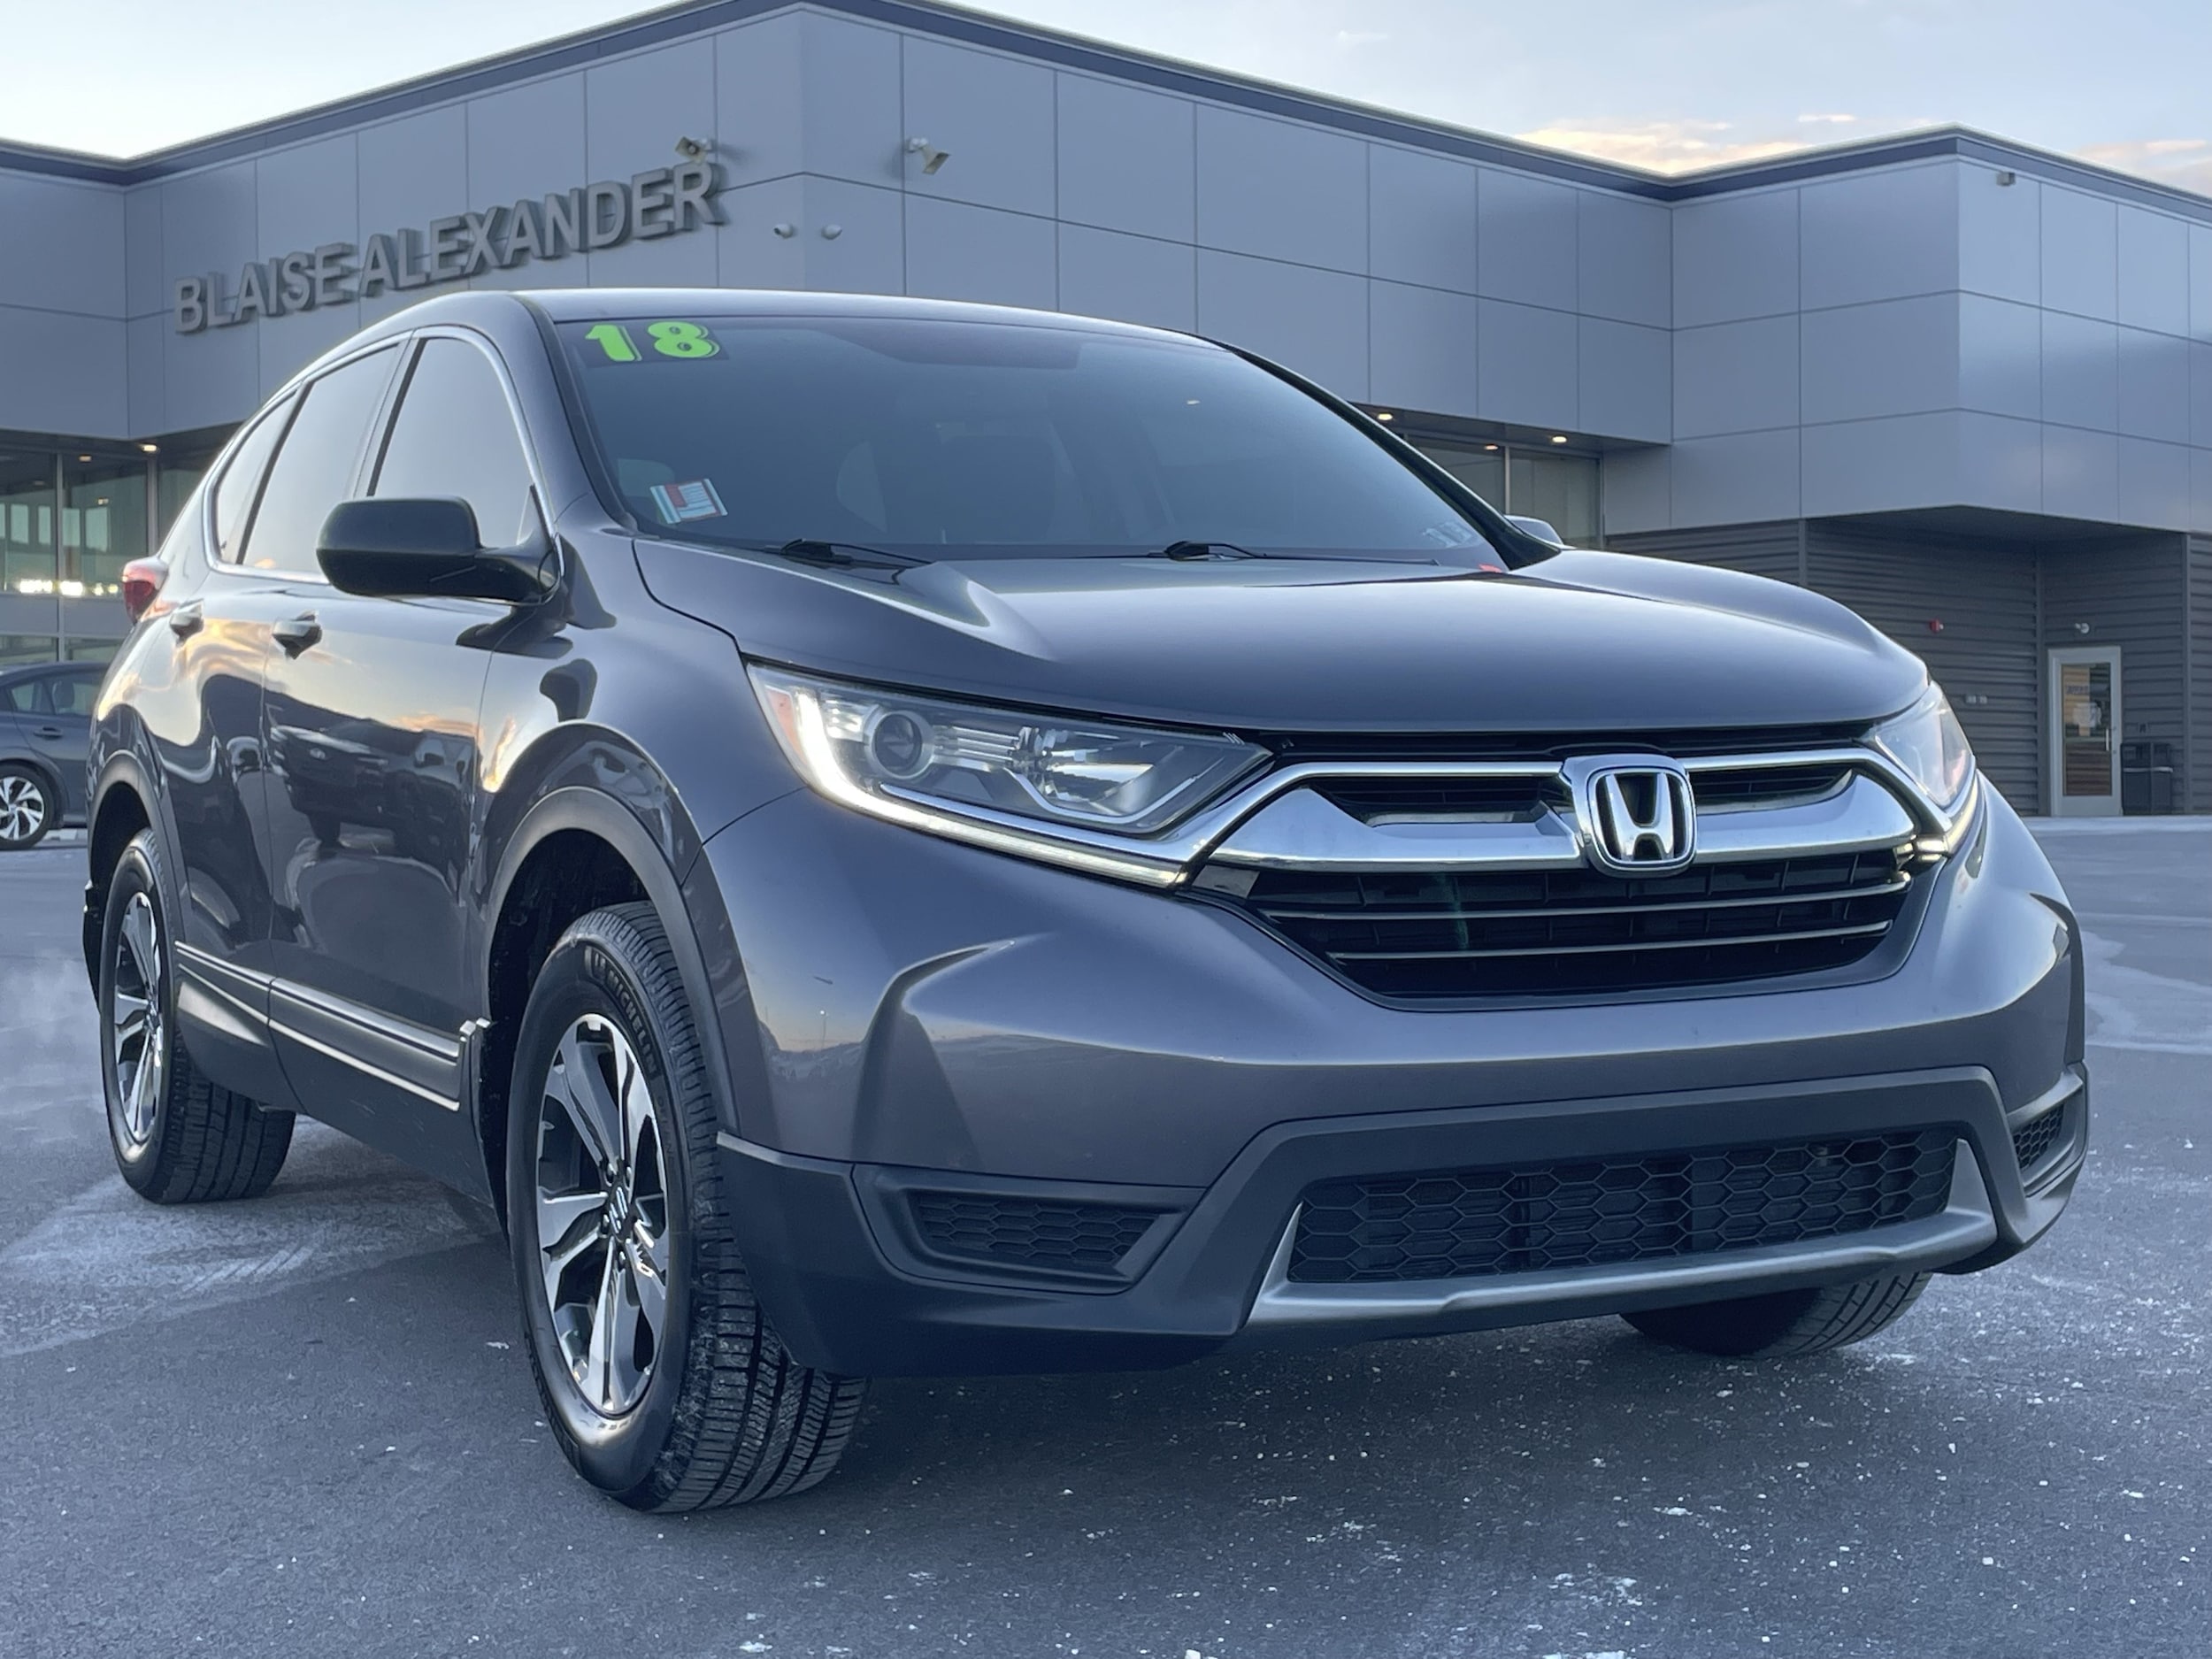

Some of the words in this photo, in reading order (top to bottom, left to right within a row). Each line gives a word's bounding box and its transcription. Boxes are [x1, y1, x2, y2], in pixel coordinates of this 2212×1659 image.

[176, 242, 357, 334] BLAISE
[359, 163, 726, 297] ALEXANDER
[585, 321, 720, 362] 18
